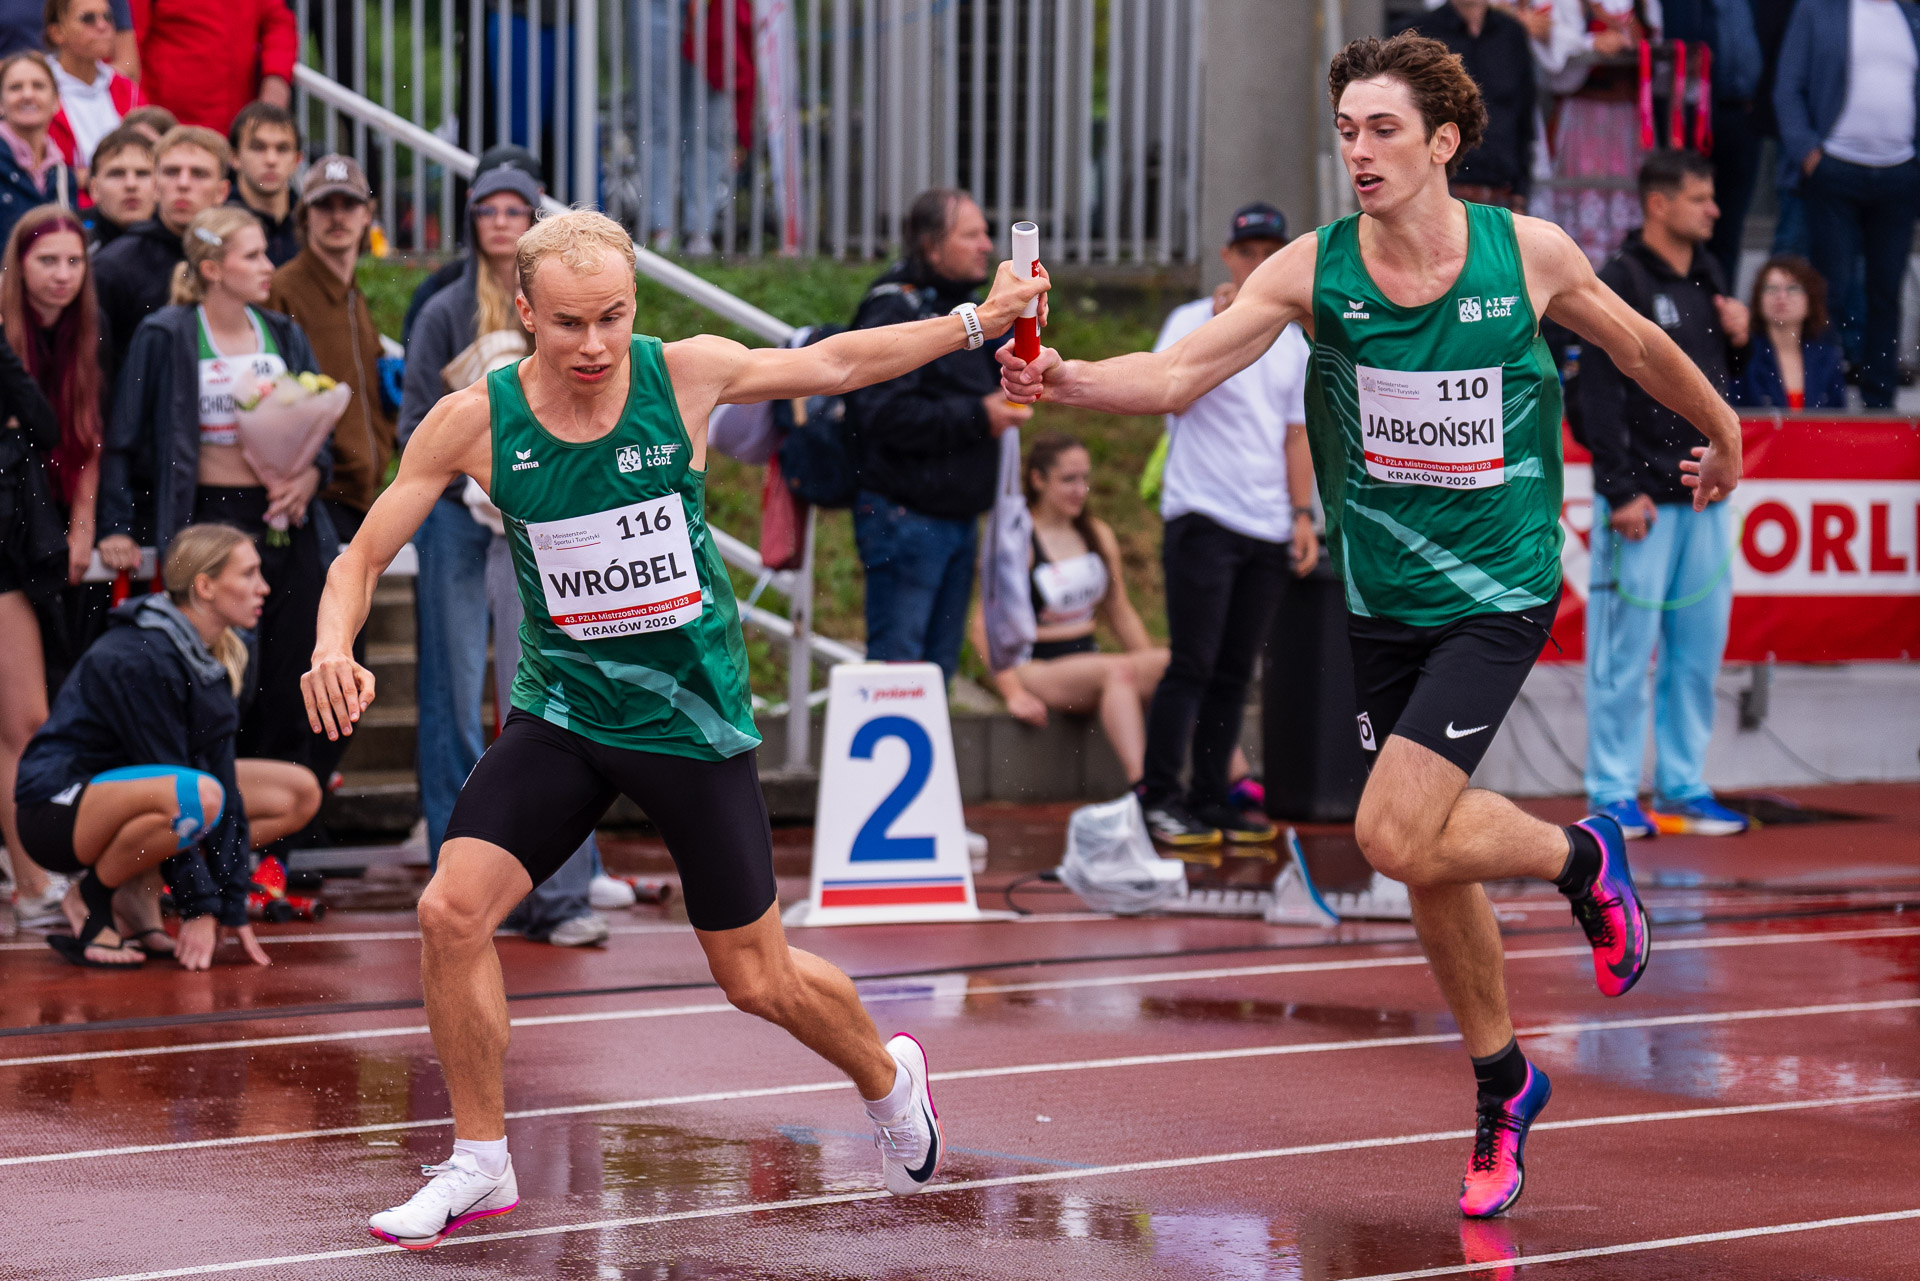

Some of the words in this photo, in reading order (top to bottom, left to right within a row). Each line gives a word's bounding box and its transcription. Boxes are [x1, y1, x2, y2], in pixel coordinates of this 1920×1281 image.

[1343, 310, 1370, 320] erima
[1486, 306, 1512, 318] ŁÓDŹ
[1376, 379, 1409, 389] Ministerstwo
[1377, 385, 1394, 393] Sportu
[1397, 387, 1420, 396] Turystyki
[1437, 376, 1489, 401] 110
[1366, 413, 1495, 447] JABŁOŃSKI
[511, 460, 540, 471] erima
[646, 454, 672, 467] ŁÓDŹ
[1374, 455, 1385, 465] 43.
[1385, 458, 1404, 467] PZLA
[1404, 460, 1450, 472] Mistrzostwa
[1452, 462, 1475, 472] Polski
[1476, 461, 1492, 471] U23
[1387, 470, 1443, 484] KRAKÓW
[1446, 476, 1477, 486] 2026
[616, 505, 672, 541] 116
[552, 530, 588, 540] Ministerstwo
[553, 538, 572, 546] Sportu
[575, 533, 600, 543] Turystyki
[1742, 500, 1920, 576] ORL
[548, 552, 687, 599] WRÓBEL
[564, 615, 578, 624] 43.
[578, 614, 597, 623] PZLA
[598, 607, 647, 621] Mistrzostwa
[648, 601, 673, 614] Polski
[673, 597, 690, 608] U23
[582, 619, 642, 637] KRAKÓW
[645, 614, 677, 629] 2026
[848, 714, 937, 863] 2
